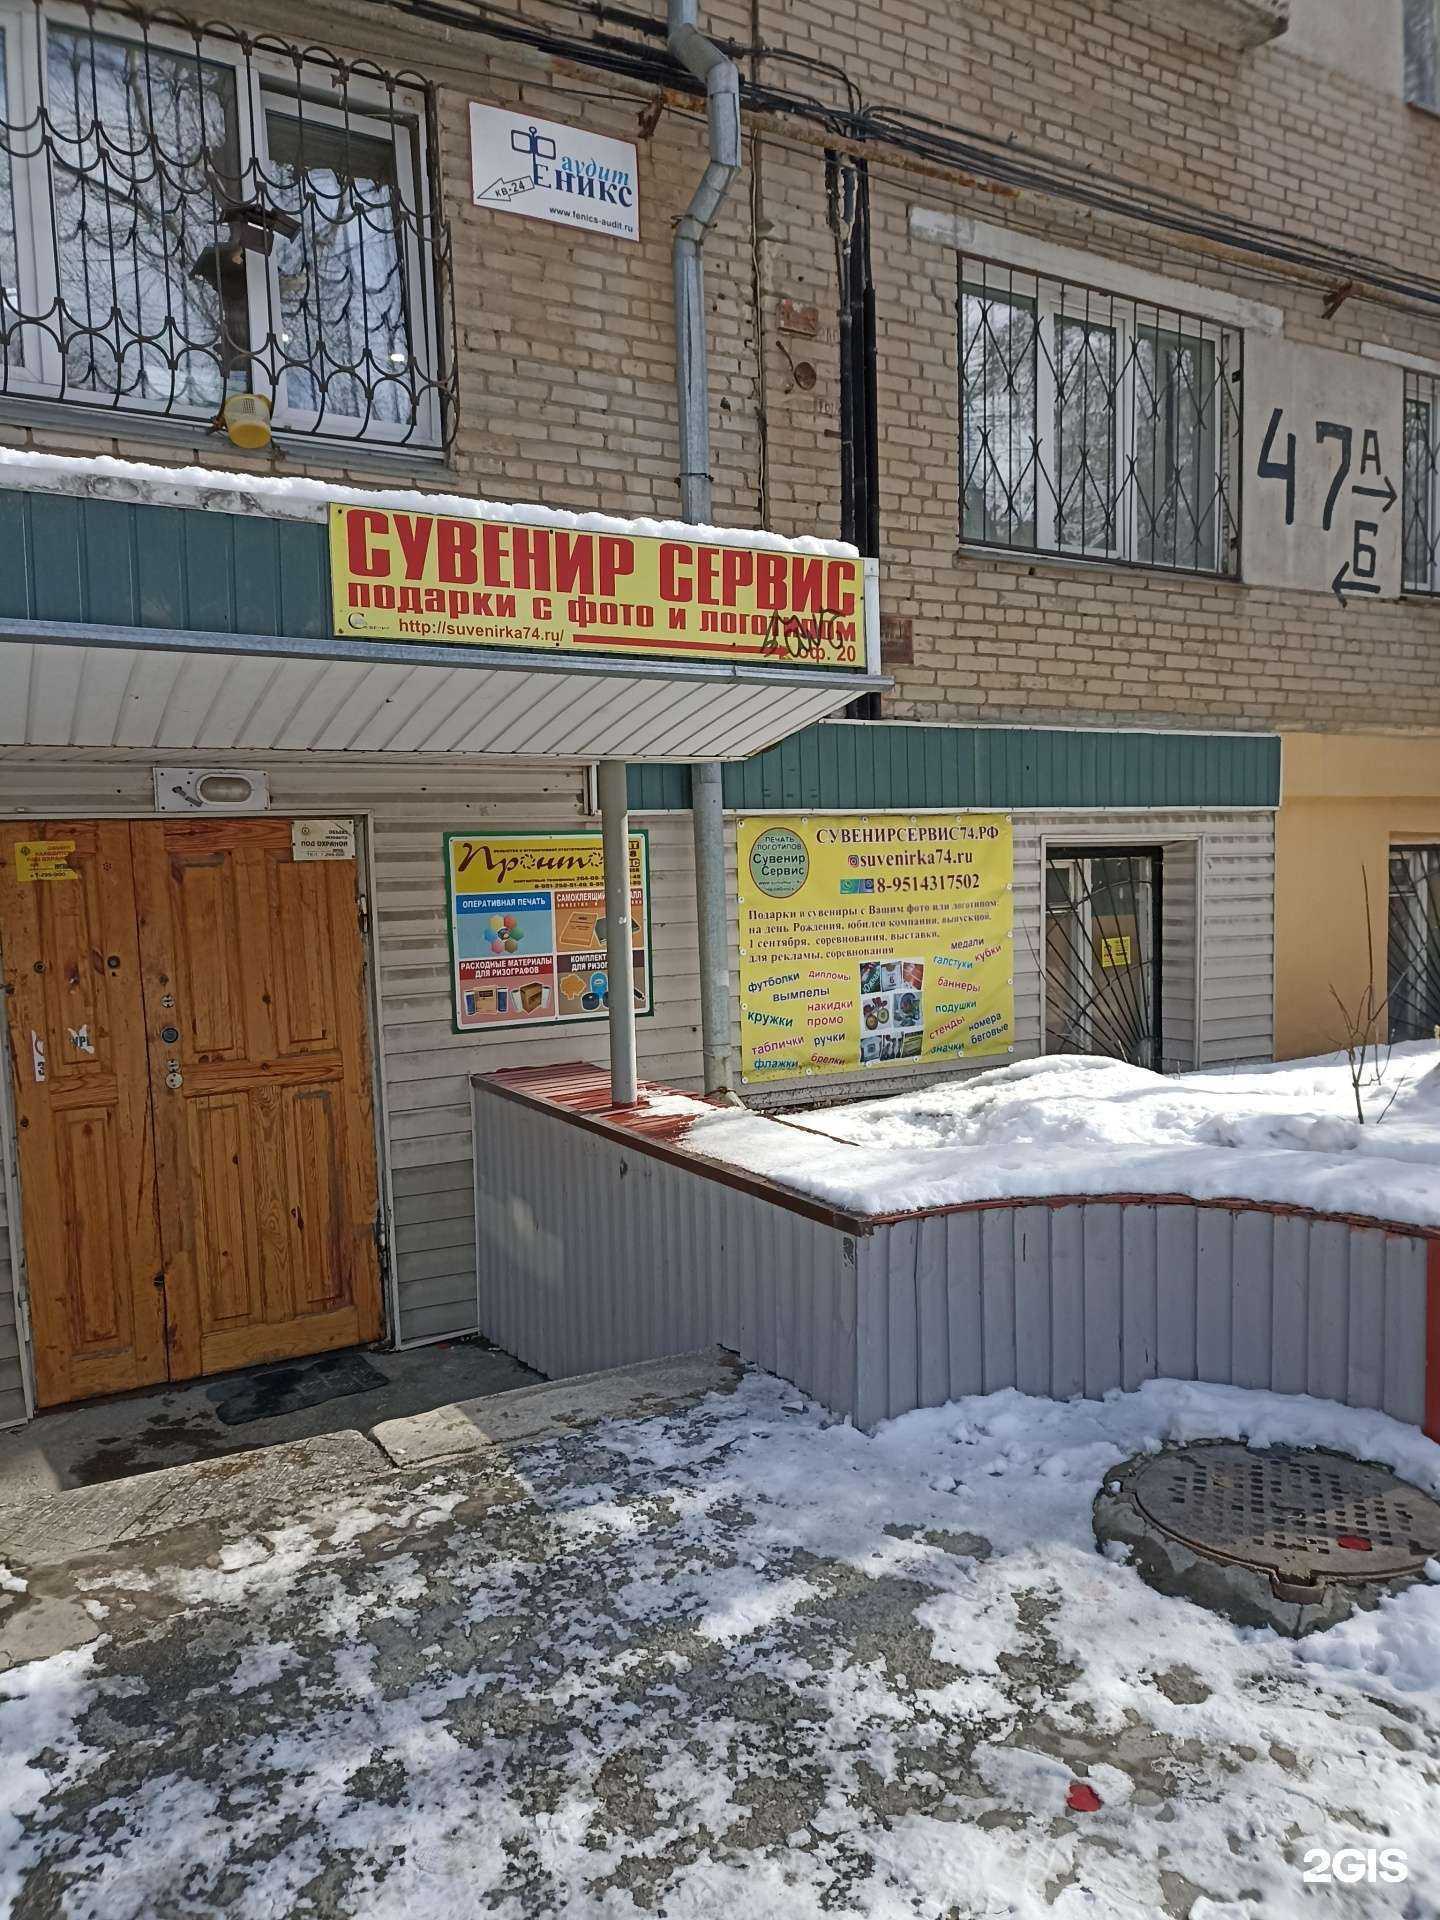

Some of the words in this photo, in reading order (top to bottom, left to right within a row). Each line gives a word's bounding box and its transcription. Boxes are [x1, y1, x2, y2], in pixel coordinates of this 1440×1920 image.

[561, 155, 629, 186] аудит
[549, 206, 634, 233] www.fenics-audit.ru
[1257, 408, 1353, 531] 47
[346, 508, 634, 597] СУВЕНИР
[659, 542, 856, 617] СЕРВИС
[347, 582, 517, 619] подарки
[532, 596, 552, 621] с
[567, 595, 654, 628] фото
[668, 607, 687, 630] и
[699, 610, 856, 642] логотипом
[398, 618, 565, 642] http://suvenirka74.ru/
[836, 645, 857, 662] 20
[816, 825, 999, 844] СУВЕНИРСЕРВИС74.РФ
[757, 843, 801, 851] ЛОГОТИПОВ
[753, 853, 806, 865] Сувенир
[860, 850, 973, 867] suvenirka74.ru
[761, 865, 805, 877] Сервис
[877, 873, 980, 893] 8-9514317502
[462, 899, 516, 909] ОПЕРАТИВНАЯ
[517, 897, 546, 907] ПЕЧАТЬ
[748, 909, 797, 922] Подарки
[807, 907, 858, 919] сувениры
[869, 904, 904, 915] Вашим
[906, 903, 930, 914] фото
[950, 937, 985, 950] медали
[826, 946, 894, 960] соревнования
[974, 944, 1002, 962] кубки
[460, 959, 507, 970] РАСХОДНЫЕ
[508, 957, 552, 967] МАТЕРИАЛЫ
[571, 963, 586, 972] ДЛЯ
[932, 955, 974, 969] галстуки
[475, 969, 491, 979] ДЛЯ
[491, 967, 540, 977] РИЗОГРАФОВ
[808, 970, 851, 981] дипломы
[748, 971, 801, 993] футболки
[937, 976, 981, 992] баннеры
[772, 987, 830, 1002] вымпелы
[807, 1000, 854, 1012] накидки
[935, 1000, 977, 1013] подушки
[748, 1011, 794, 1027] кружки
[807, 1016, 844, 1028] промо
[968, 1012, 1002, 1032] номера
[929, 1016, 966, 1040] стенды
[970, 1022, 1009, 1045] беговые
[752, 1035, 805, 1056] таблички
[814, 1032, 846, 1047] ручки
[754, 1058, 799, 1071] флажки
[811, 1052, 846, 1066] брелки
